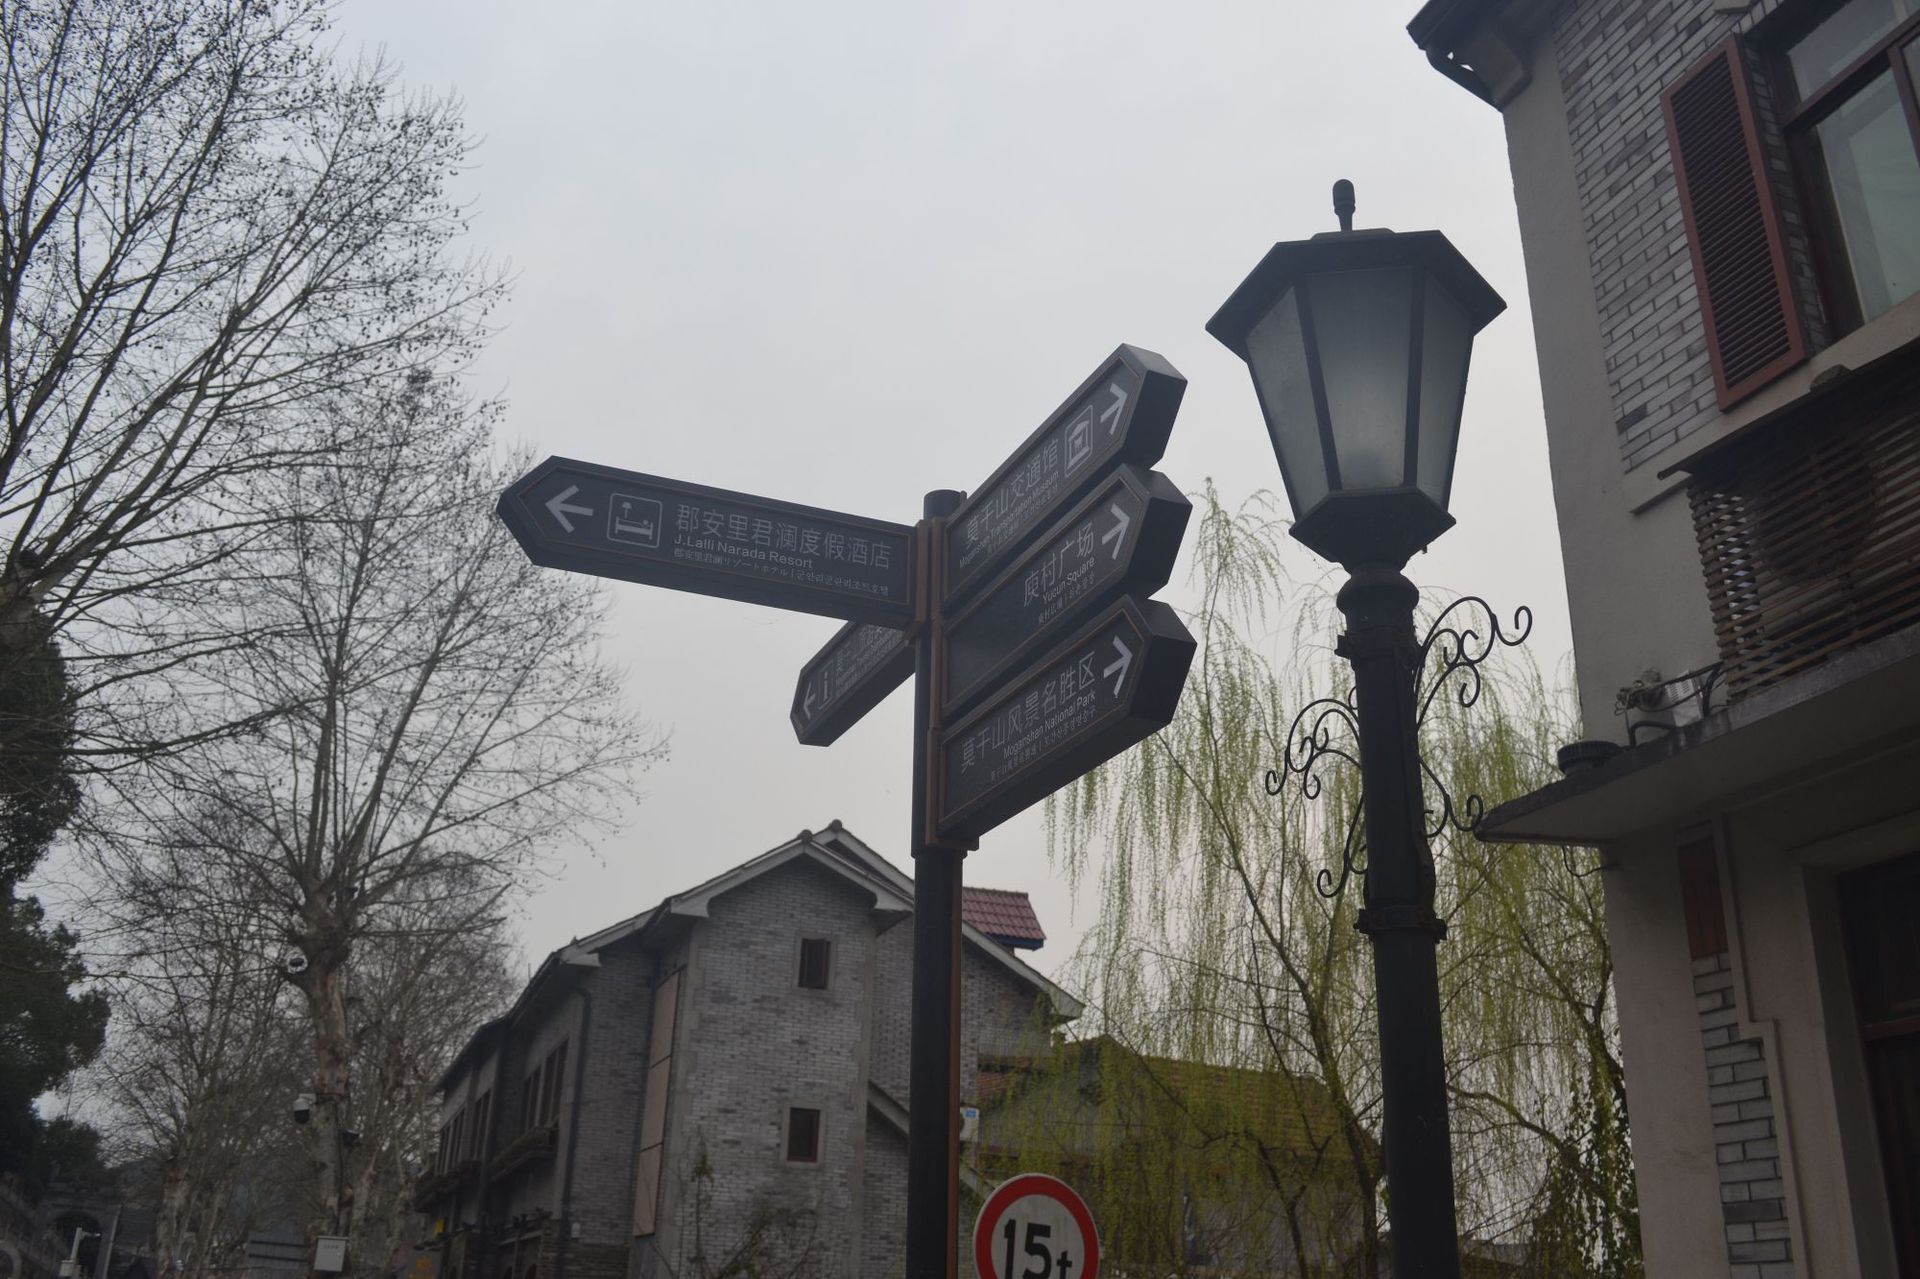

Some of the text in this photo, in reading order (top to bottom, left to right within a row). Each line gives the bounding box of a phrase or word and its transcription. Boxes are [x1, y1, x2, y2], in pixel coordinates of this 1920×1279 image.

[966, 439, 1059, 549] 莫干山交通馆
[1032, 471, 1060, 500] Museum
[675, 503, 892, 569] 郡安里君澜度假酒店
[717, 541, 766, 560] Narada
[769, 551, 813, 569] Resort
[1023, 520, 1095, 607] 庾村广场
[1042, 580, 1066, 604] Yucun
[1066, 556, 1095, 586] Square
[961, 650, 1096, 776] 莫干山风景名胜区
[1003, 688, 1096, 759] Moganshan National Park
